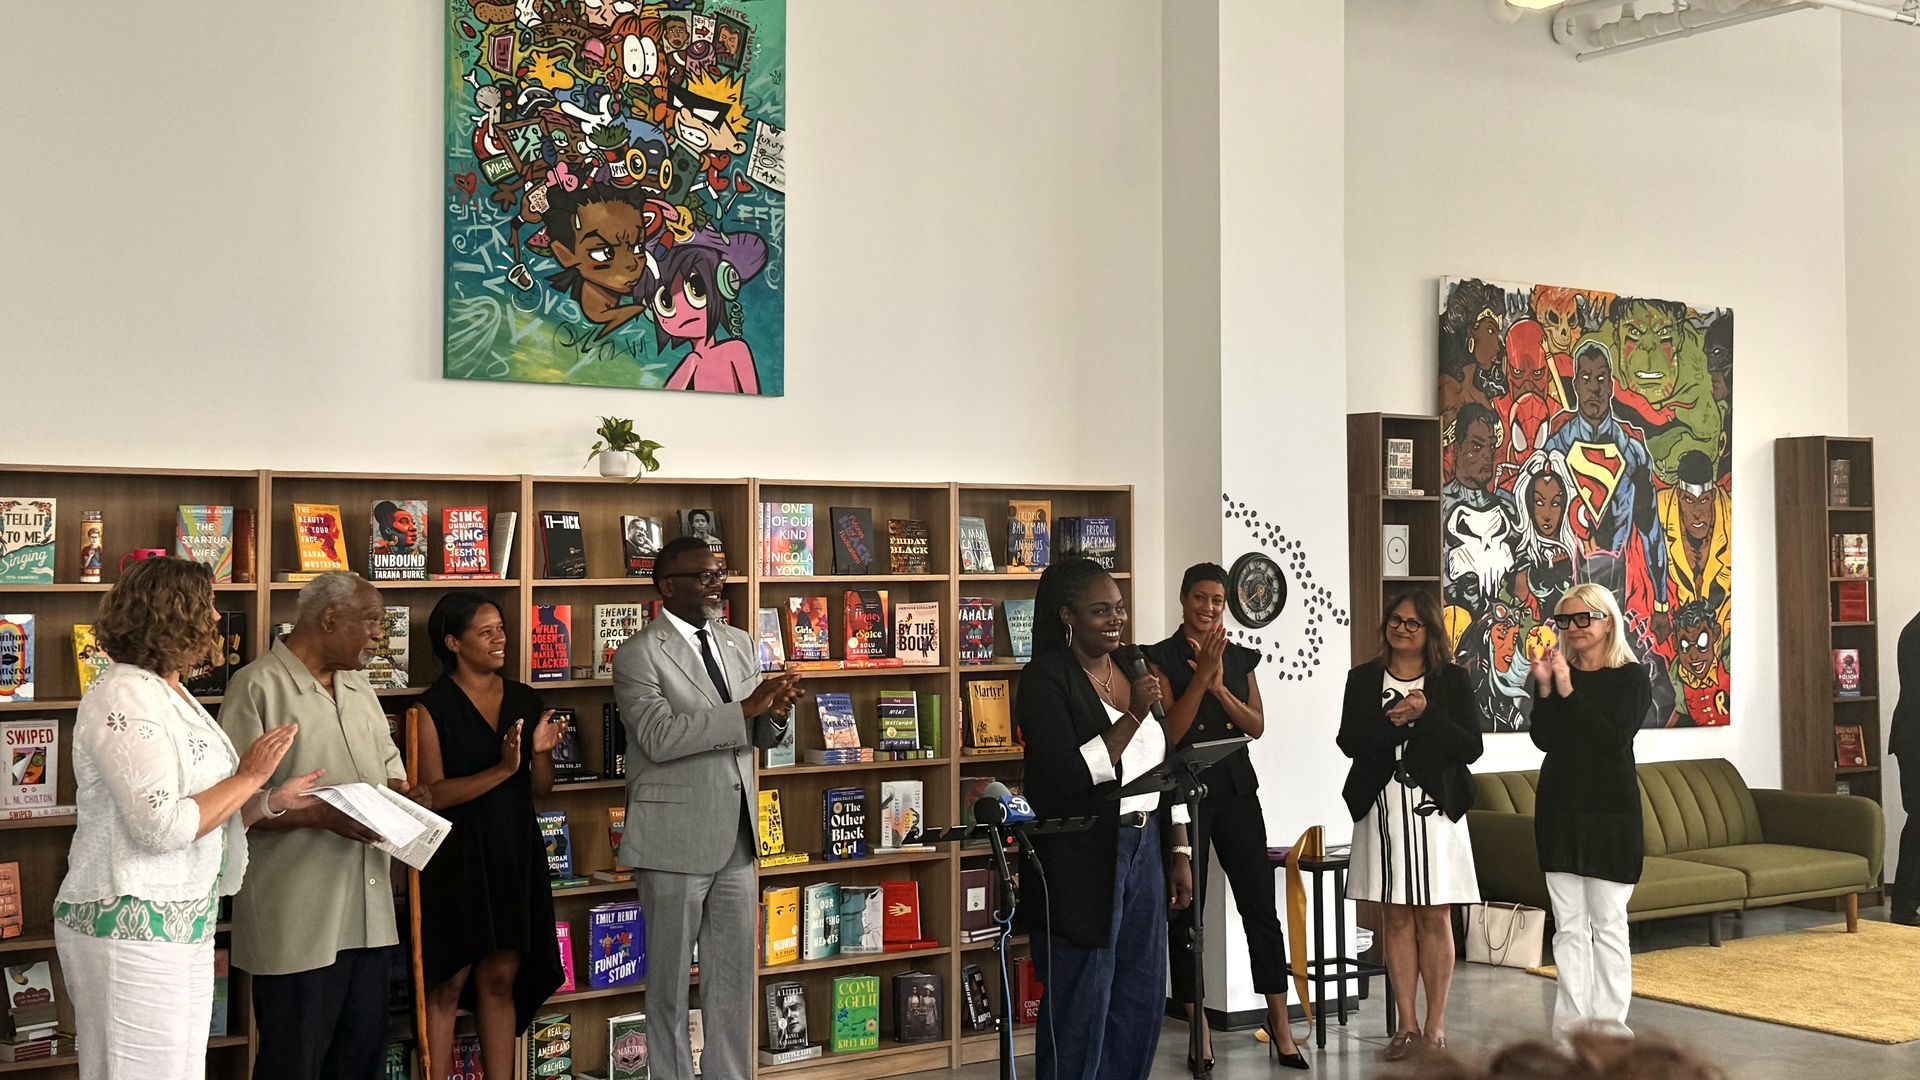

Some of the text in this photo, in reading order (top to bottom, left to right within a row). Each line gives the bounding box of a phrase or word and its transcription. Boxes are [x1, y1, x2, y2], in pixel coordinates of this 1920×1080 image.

[755, 166, 777, 185] TAX
[781, 503, 806, 514] ONE
[5, 513, 46, 526] TELL IT
[298, 516, 325, 524] BEAUTY
[772, 516, 814, 527] OF OUR
[1018, 511, 1040, 521] FREDRIK
[196, 522, 215, 531] THE
[300, 526, 329, 535] OF YOUR
[1012, 521, 1046, 535] BACKMAN
[1086, 524, 1110, 536] FREDRIK
[6, 531, 42, 544] TO ME
[181, 535, 228, 545] STARTUP
[452, 529, 484, 541] SING
[780, 529, 807, 540] KIND
[968, 528, 985, 541] MAN
[890, 537, 927, 545] FRIDAY
[961, 538, 989, 551] CALLED
[1014, 539, 1043, 551] ANXIOUS
[1081, 536, 1116, 551] BACKMAN
[192, 548, 217, 558] WIFE
[449, 547, 486, 557] JESMYN
[890, 546, 929, 555] BLACK
[0, 549, 49, 576] Singing
[374, 554, 425, 568] UNBOUND
[450, 557, 486, 568] WARD
[771, 552, 814, 563] NICOLA
[1016, 551, 1040, 564] PEOPLE
[375, 570, 425, 580] TARANA BURKE
[776, 565, 808, 576] YOON
[605, 607, 638, 617] HEAVEN
[601, 618, 638, 628] & EARTH
[899, 622, 935, 636] BY THE
[535, 625, 559, 634] WHAT
[795, 626, 813, 634] Girls
[856, 629, 883, 641] Spice
[898, 635, 936, 651] BOOK
[977, 650, 993, 659] MAY
[532, 658, 569, 669] BLACKER
[974, 684, 1005, 700] Martyr!
[1714, 690, 1730, 716] R
[6, 728, 54, 745] SWIPED
[24, 793, 53, 804] CHILTON
[844, 802, 861, 813] The
[9, 810, 33, 820] SWIPED
[831, 813, 866, 828] Other
[831, 826, 865, 842] Black
[832, 840, 858, 856] Grl
[547, 854, 568, 863] ENDAN
[820, 898, 834, 910] OUR
[595, 909, 638, 925] EMILY HENRY
[594, 949, 624, 975] FUNNY
[608, 959, 637, 983] STORY
[782, 987, 804, 996] LITTLE
[839, 980, 877, 995] COME
[845, 994, 867, 1008] GET
[868, 993, 877, 1007] IT
[547, 1026, 562, 1038] REAL
[453, 1043, 481, 1054] HOUS
[538, 1040, 571, 1058] AMERICANS
[543, 1060, 565, 1073] RACHEL
